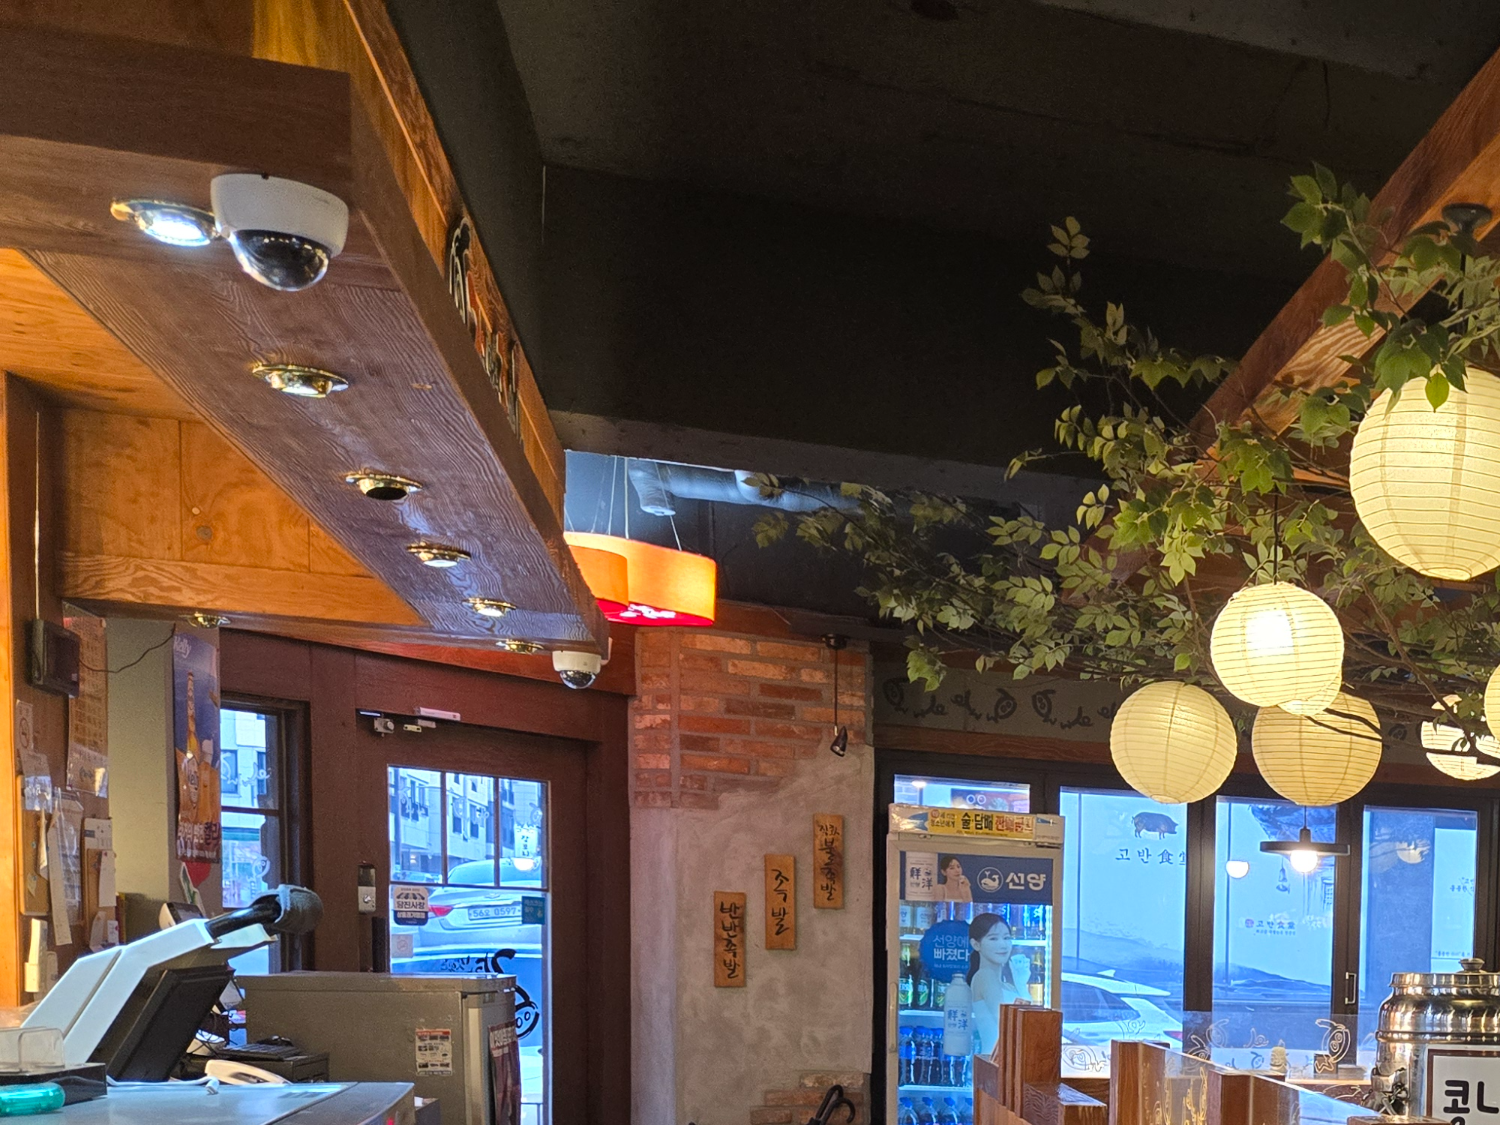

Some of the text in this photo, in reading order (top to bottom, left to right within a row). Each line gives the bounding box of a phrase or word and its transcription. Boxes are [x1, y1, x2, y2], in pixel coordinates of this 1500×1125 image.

[1005, 872, 1047, 891] 선양
[771, 869, 789, 936] 족발
[933, 934, 969, 948] 선양에
[933, 949, 970, 962] 빠졌다
